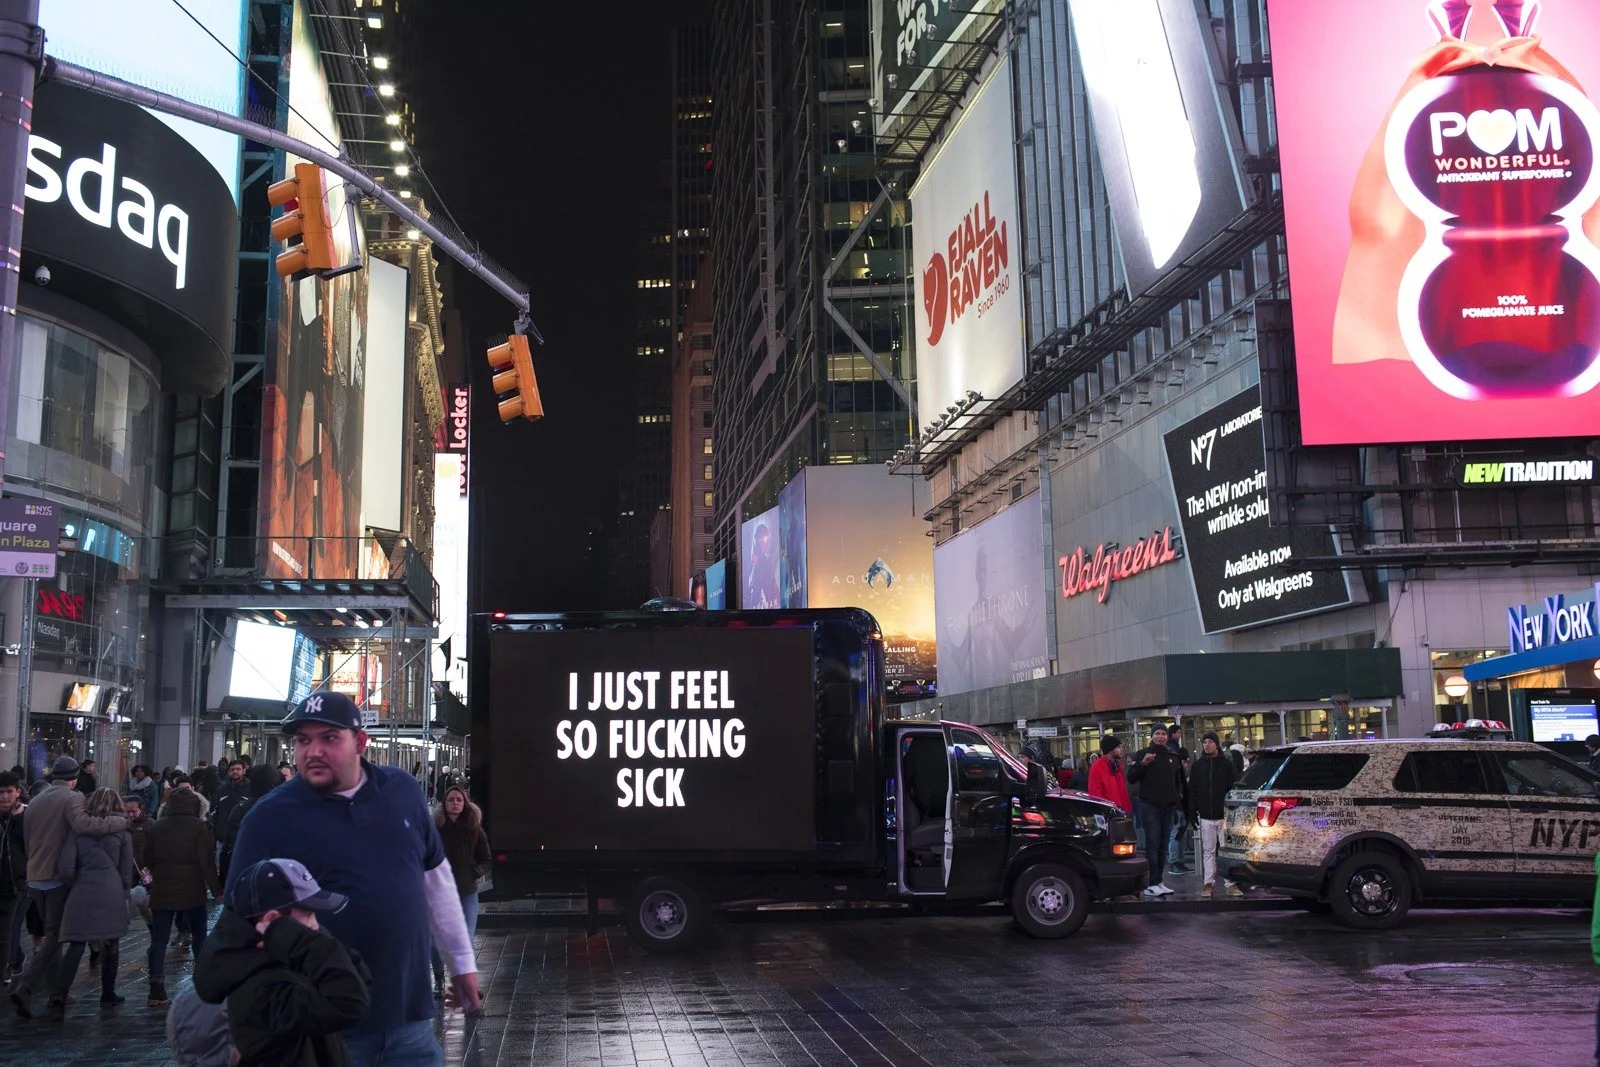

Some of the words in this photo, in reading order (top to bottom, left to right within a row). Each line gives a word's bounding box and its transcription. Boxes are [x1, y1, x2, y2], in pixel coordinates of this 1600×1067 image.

[897, 2, 926, 66] FOR
[1437, 171, 1500, 183] ANTIOXIDANT
[1502, 169, 1564, 181] SUPERPOWER
[977, 294, 994, 319] Since
[994, 274, 1010, 302] 1960
[1462, 306, 1536, 318] POMEGRANATE
[1537, 305, 1565, 315] JUICE
[1497, 295, 1528, 306] 100%
[450, 388, 467, 449] Locker
[36, 504, 53, 513] NYC
[1186, 496, 1205, 518] The
[1205, 481, 1231, 510] NEW
[1207, 503, 1245, 535] wrinkle
[13, 535, 50, 549] Plaza
[832, 573, 930, 586] AQUAMAN
[1059, 525, 1176, 604] Walgreens
[1224, 550, 1269, 578] Available
[1218, 586, 1242, 610] Only
[1242, 583, 1254, 603] at
[1254, 570, 1313, 600] Walgreens
[569, 672, 578, 711] I
[588, 671, 661, 711] JUST
[670, 670, 735, 710] FEEL
[556, 719, 598, 760] SO
[609, 718, 746, 759] FUCKING
[616, 767, 685, 808] SICK
[1451, 836, 1471, 846] 2018
[1452, 825, 1469, 835] DAY
